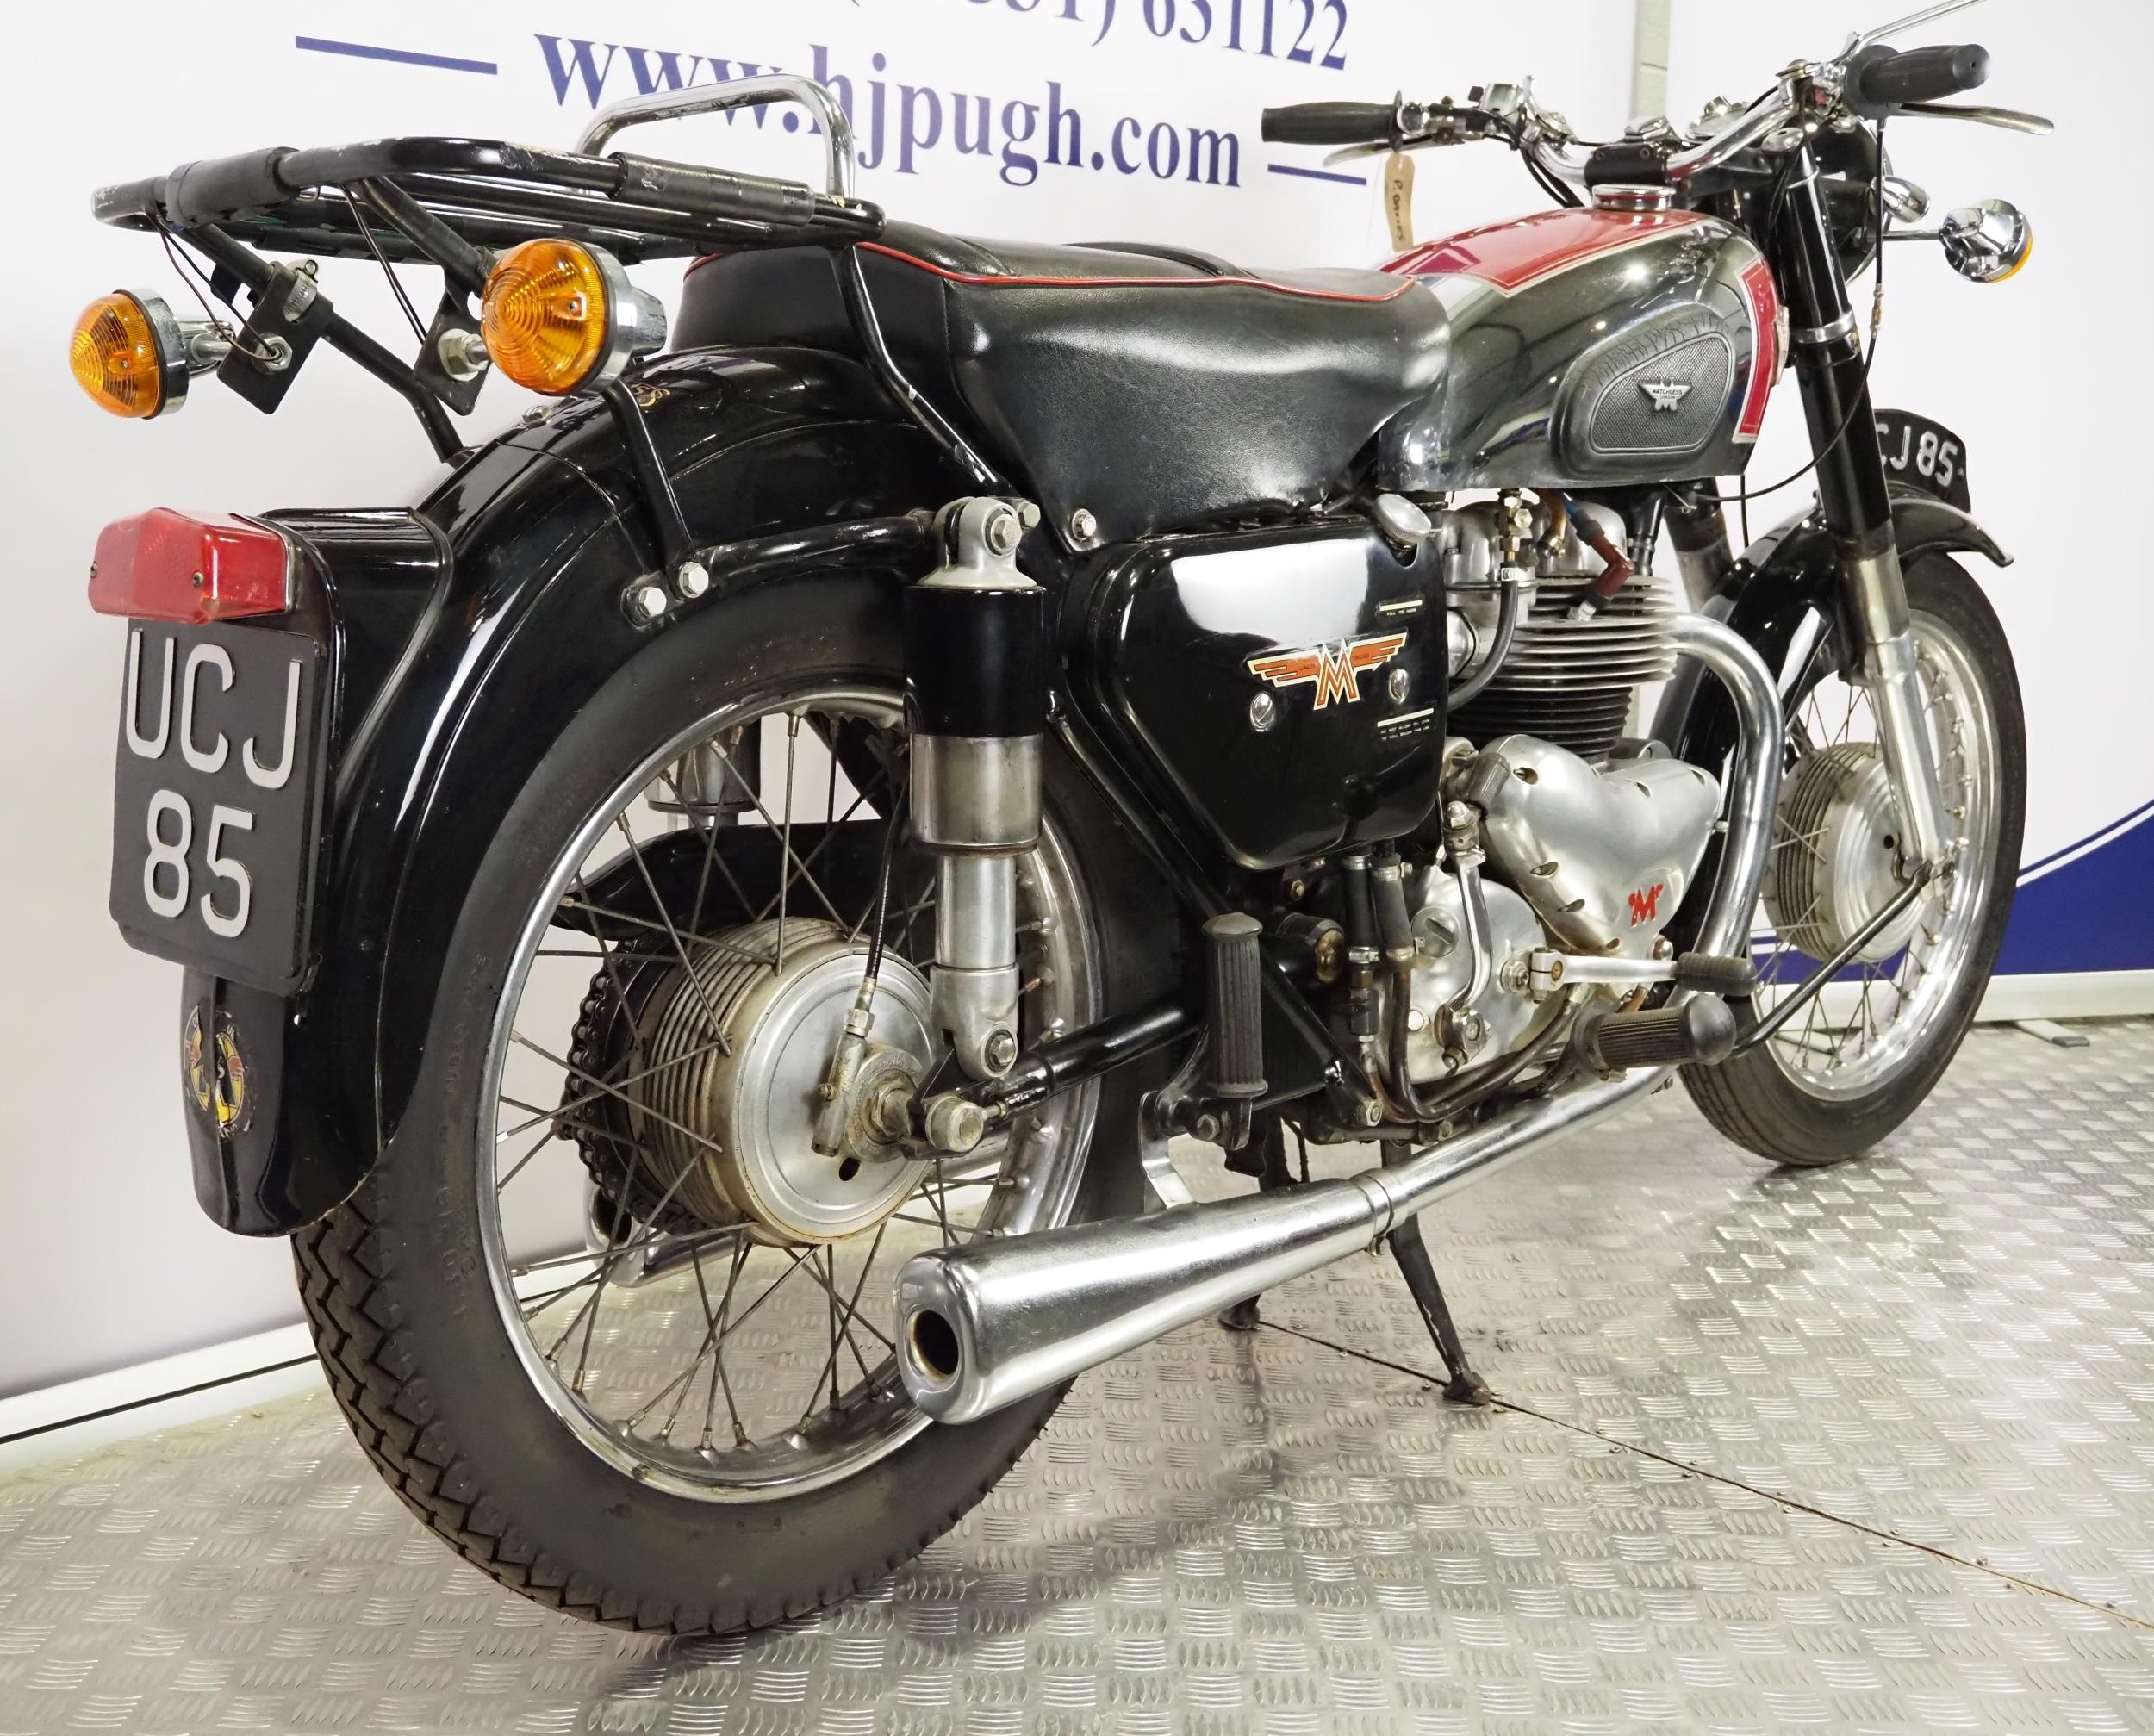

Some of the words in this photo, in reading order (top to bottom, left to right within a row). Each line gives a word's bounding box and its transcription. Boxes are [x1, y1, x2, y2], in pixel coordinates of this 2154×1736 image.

[533, 34, 1241, 188] www.hjpugh.com
[1916, 431, 1958, 487] 85
[126, 630, 301, 790] UCJ
[143, 789, 253, 938] 85
